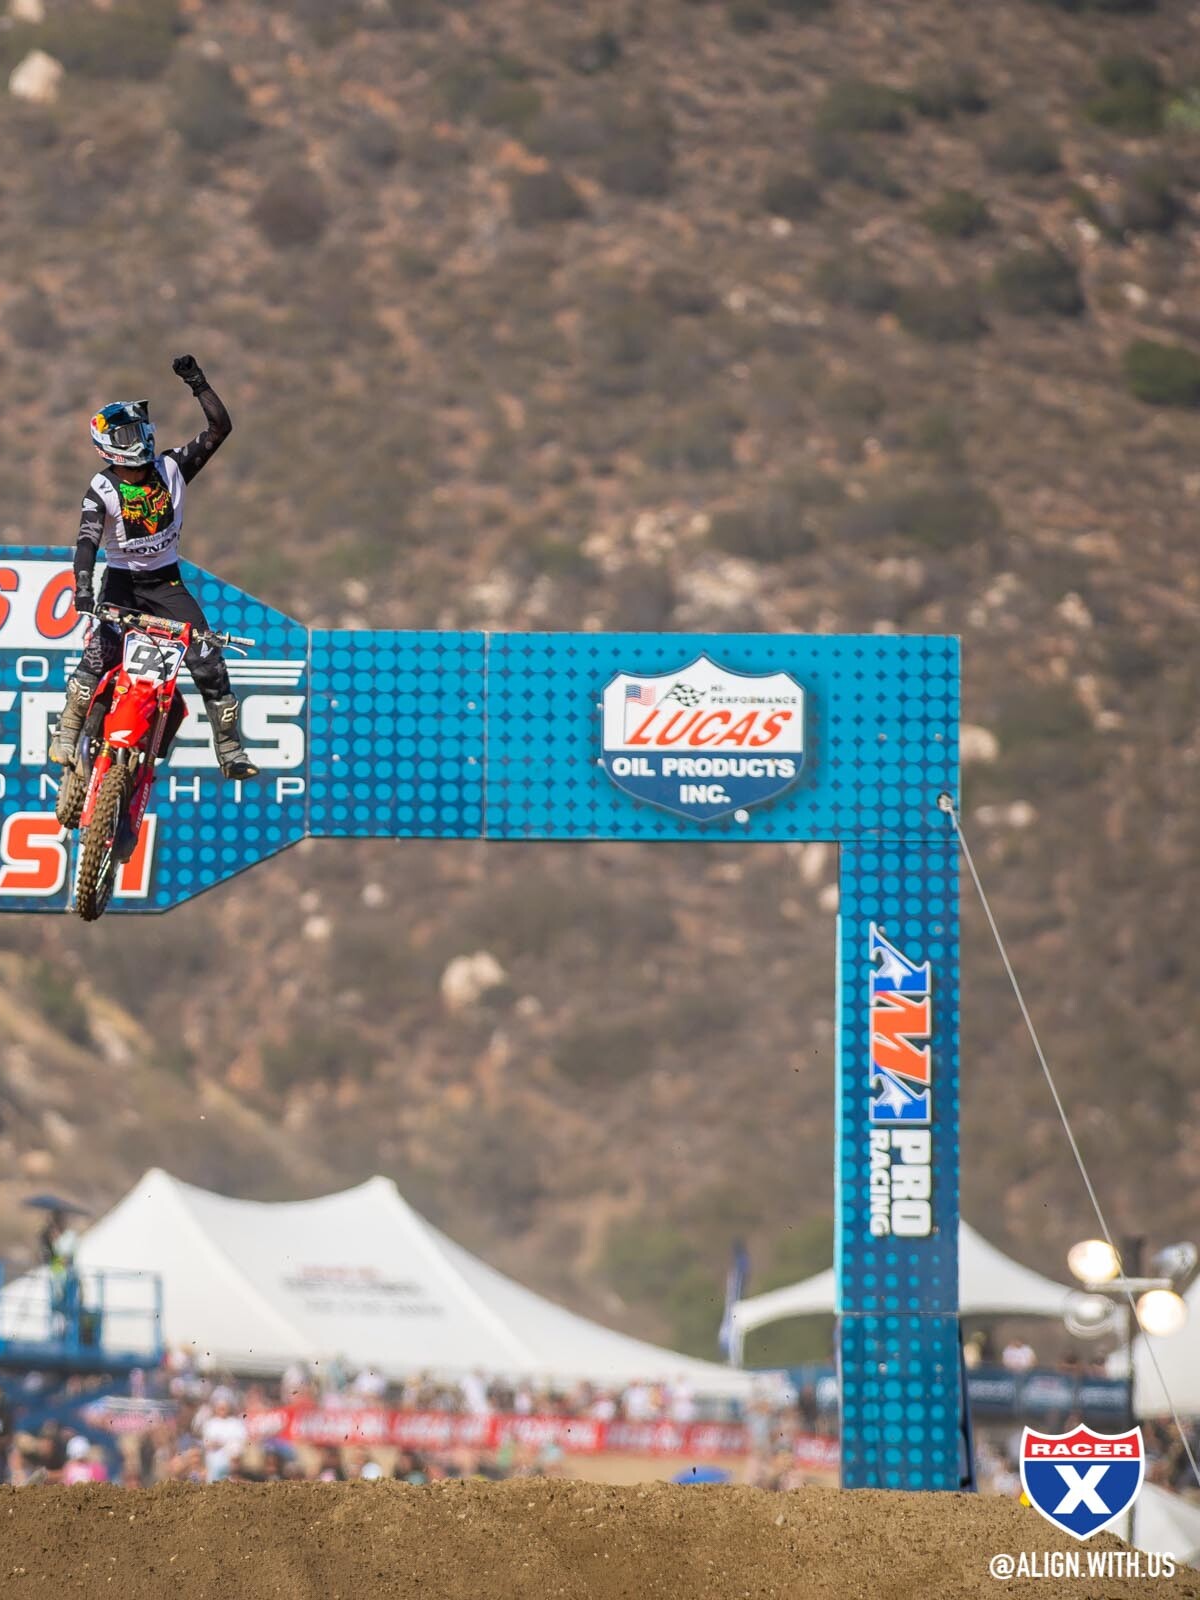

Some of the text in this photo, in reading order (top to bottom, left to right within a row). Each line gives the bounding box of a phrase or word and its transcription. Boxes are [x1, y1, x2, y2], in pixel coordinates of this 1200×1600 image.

[127, 645, 175, 680] 94
[710, 695, 798, 705] PERFORMANCE
[623, 709, 793, 747] LUCAS
[612, 757, 796, 779] OIL PRODUCTS
[135, 783, 150, 830] DUNLOP
[679, 784, 732, 804] INC.
[869, 920, 932, 1125] AMA
[869, 1129, 891, 1237] RACING
[891, 1129, 932, 1237] PRO
